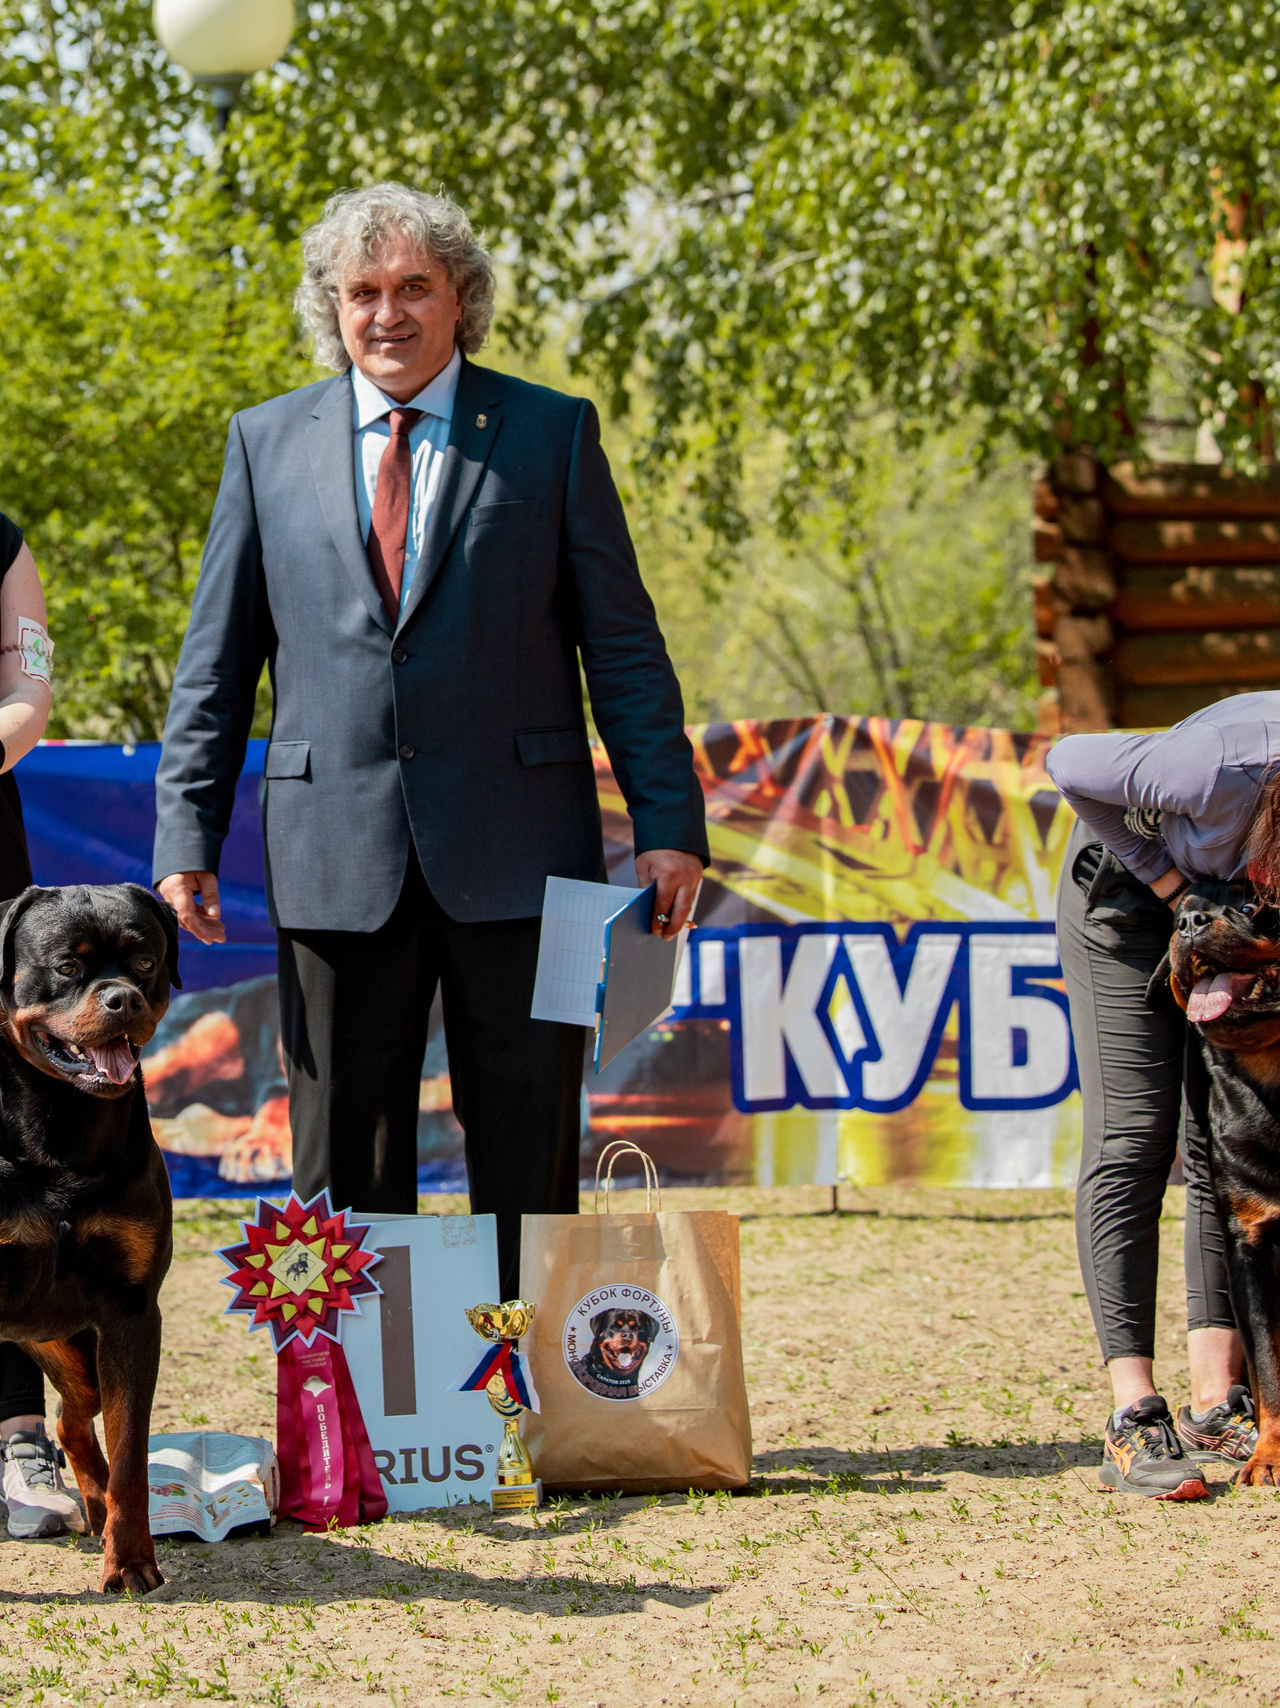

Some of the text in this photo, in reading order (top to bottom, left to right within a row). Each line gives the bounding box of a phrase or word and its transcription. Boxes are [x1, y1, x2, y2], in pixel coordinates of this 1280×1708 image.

[368, 1245, 417, 1416] 1
[577, 1287, 674, 1335] КУБОК ФОРТУНЫ
[628, 1352, 674, 1397] ВЫСТАВКА
[316, 1403, 332, 1490] ПОБЕДИТЕЛЬ
